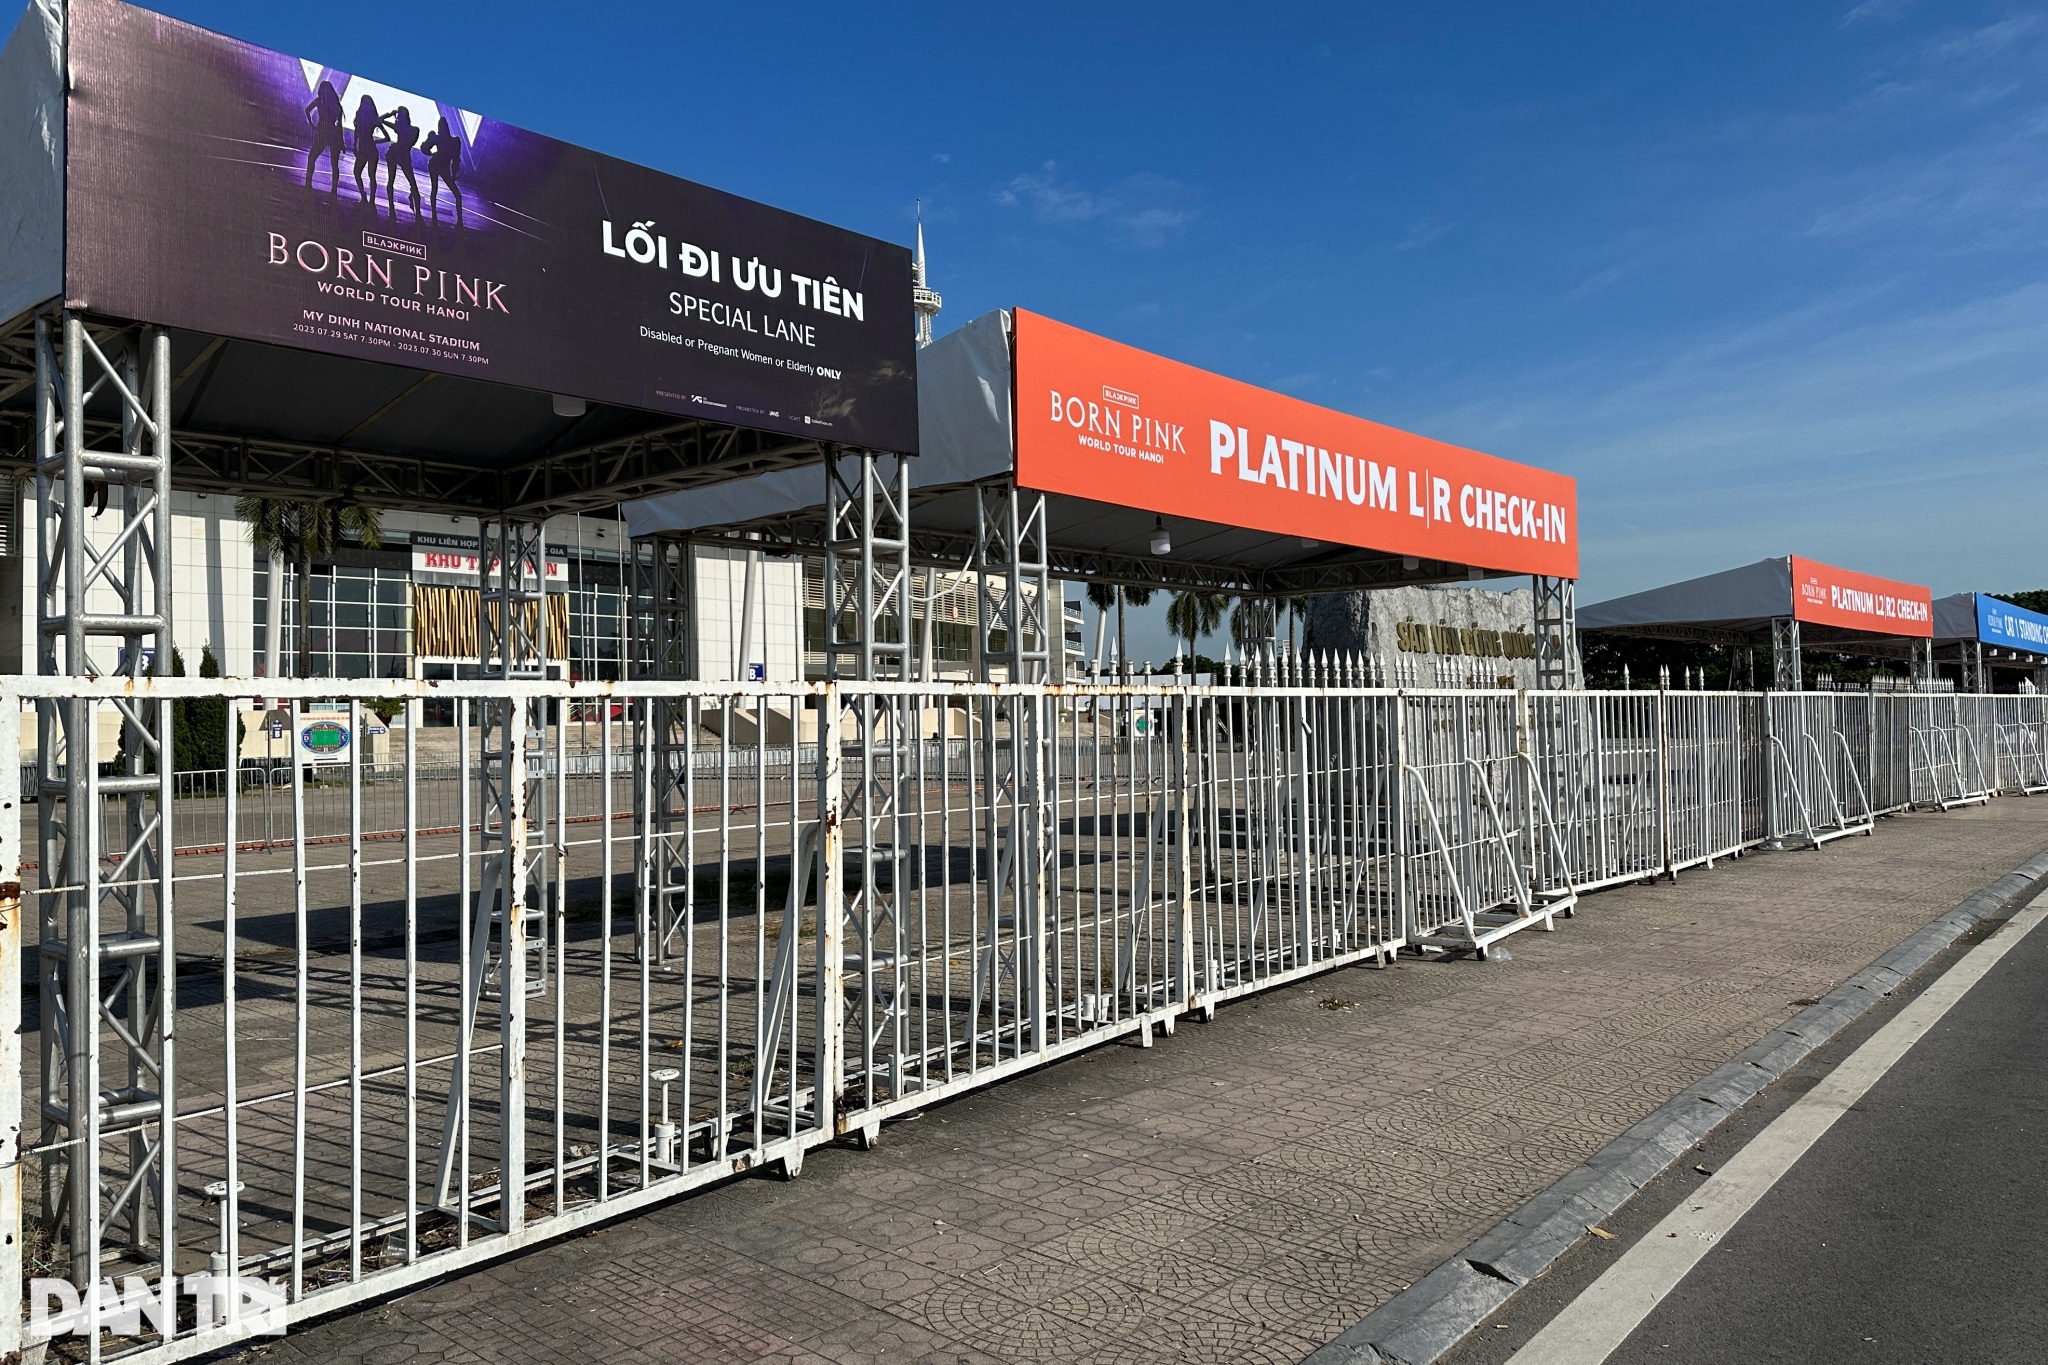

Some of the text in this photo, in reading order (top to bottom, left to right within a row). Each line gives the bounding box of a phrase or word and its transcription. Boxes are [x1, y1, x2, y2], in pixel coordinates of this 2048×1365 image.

[267, 231, 511, 314] BORN PINK
[602, 220, 865, 322] LỐI ĐI ƯU TIÊN
[317, 281, 470, 321] WORLD TOUR HANOI
[669, 291, 816, 347] SPECIAL LANE
[293, 324, 341, 339] 2023.07.29
[343, 332, 358, 342] SAT
[361, 335, 391, 348] 7:30PM
[398, 342, 442, 357] 2023.07.30
[443, 350, 459, 360] SUN
[461, 353, 489, 364] 7:30PM
[303, 309, 480, 351] MY DINH NATIONAL STADIUM
[640, 325, 842, 380] Disabled or Pregnant Women or Elderly ONLY
[1050, 390, 1186, 454] BORN PINK
[1078, 434, 1164, 464] WORLD TOUR HANOI
[1209, 419, 1398, 512] PLATINUM
[1459, 484, 1566, 544] CHECK-IN
[417, 535, 436, 544] KHU
[438, 537, 458, 546] LIÊN
[460, 540, 478, 549] HỢP
[550, 547, 565, 556] GIA
[425, 552, 462, 569] KHU
[1831, 585, 1874, 614] PLATINUM
[1897, 599, 1929, 621] CHECK-IN
[1396, 615, 1430, 654] SÂN
